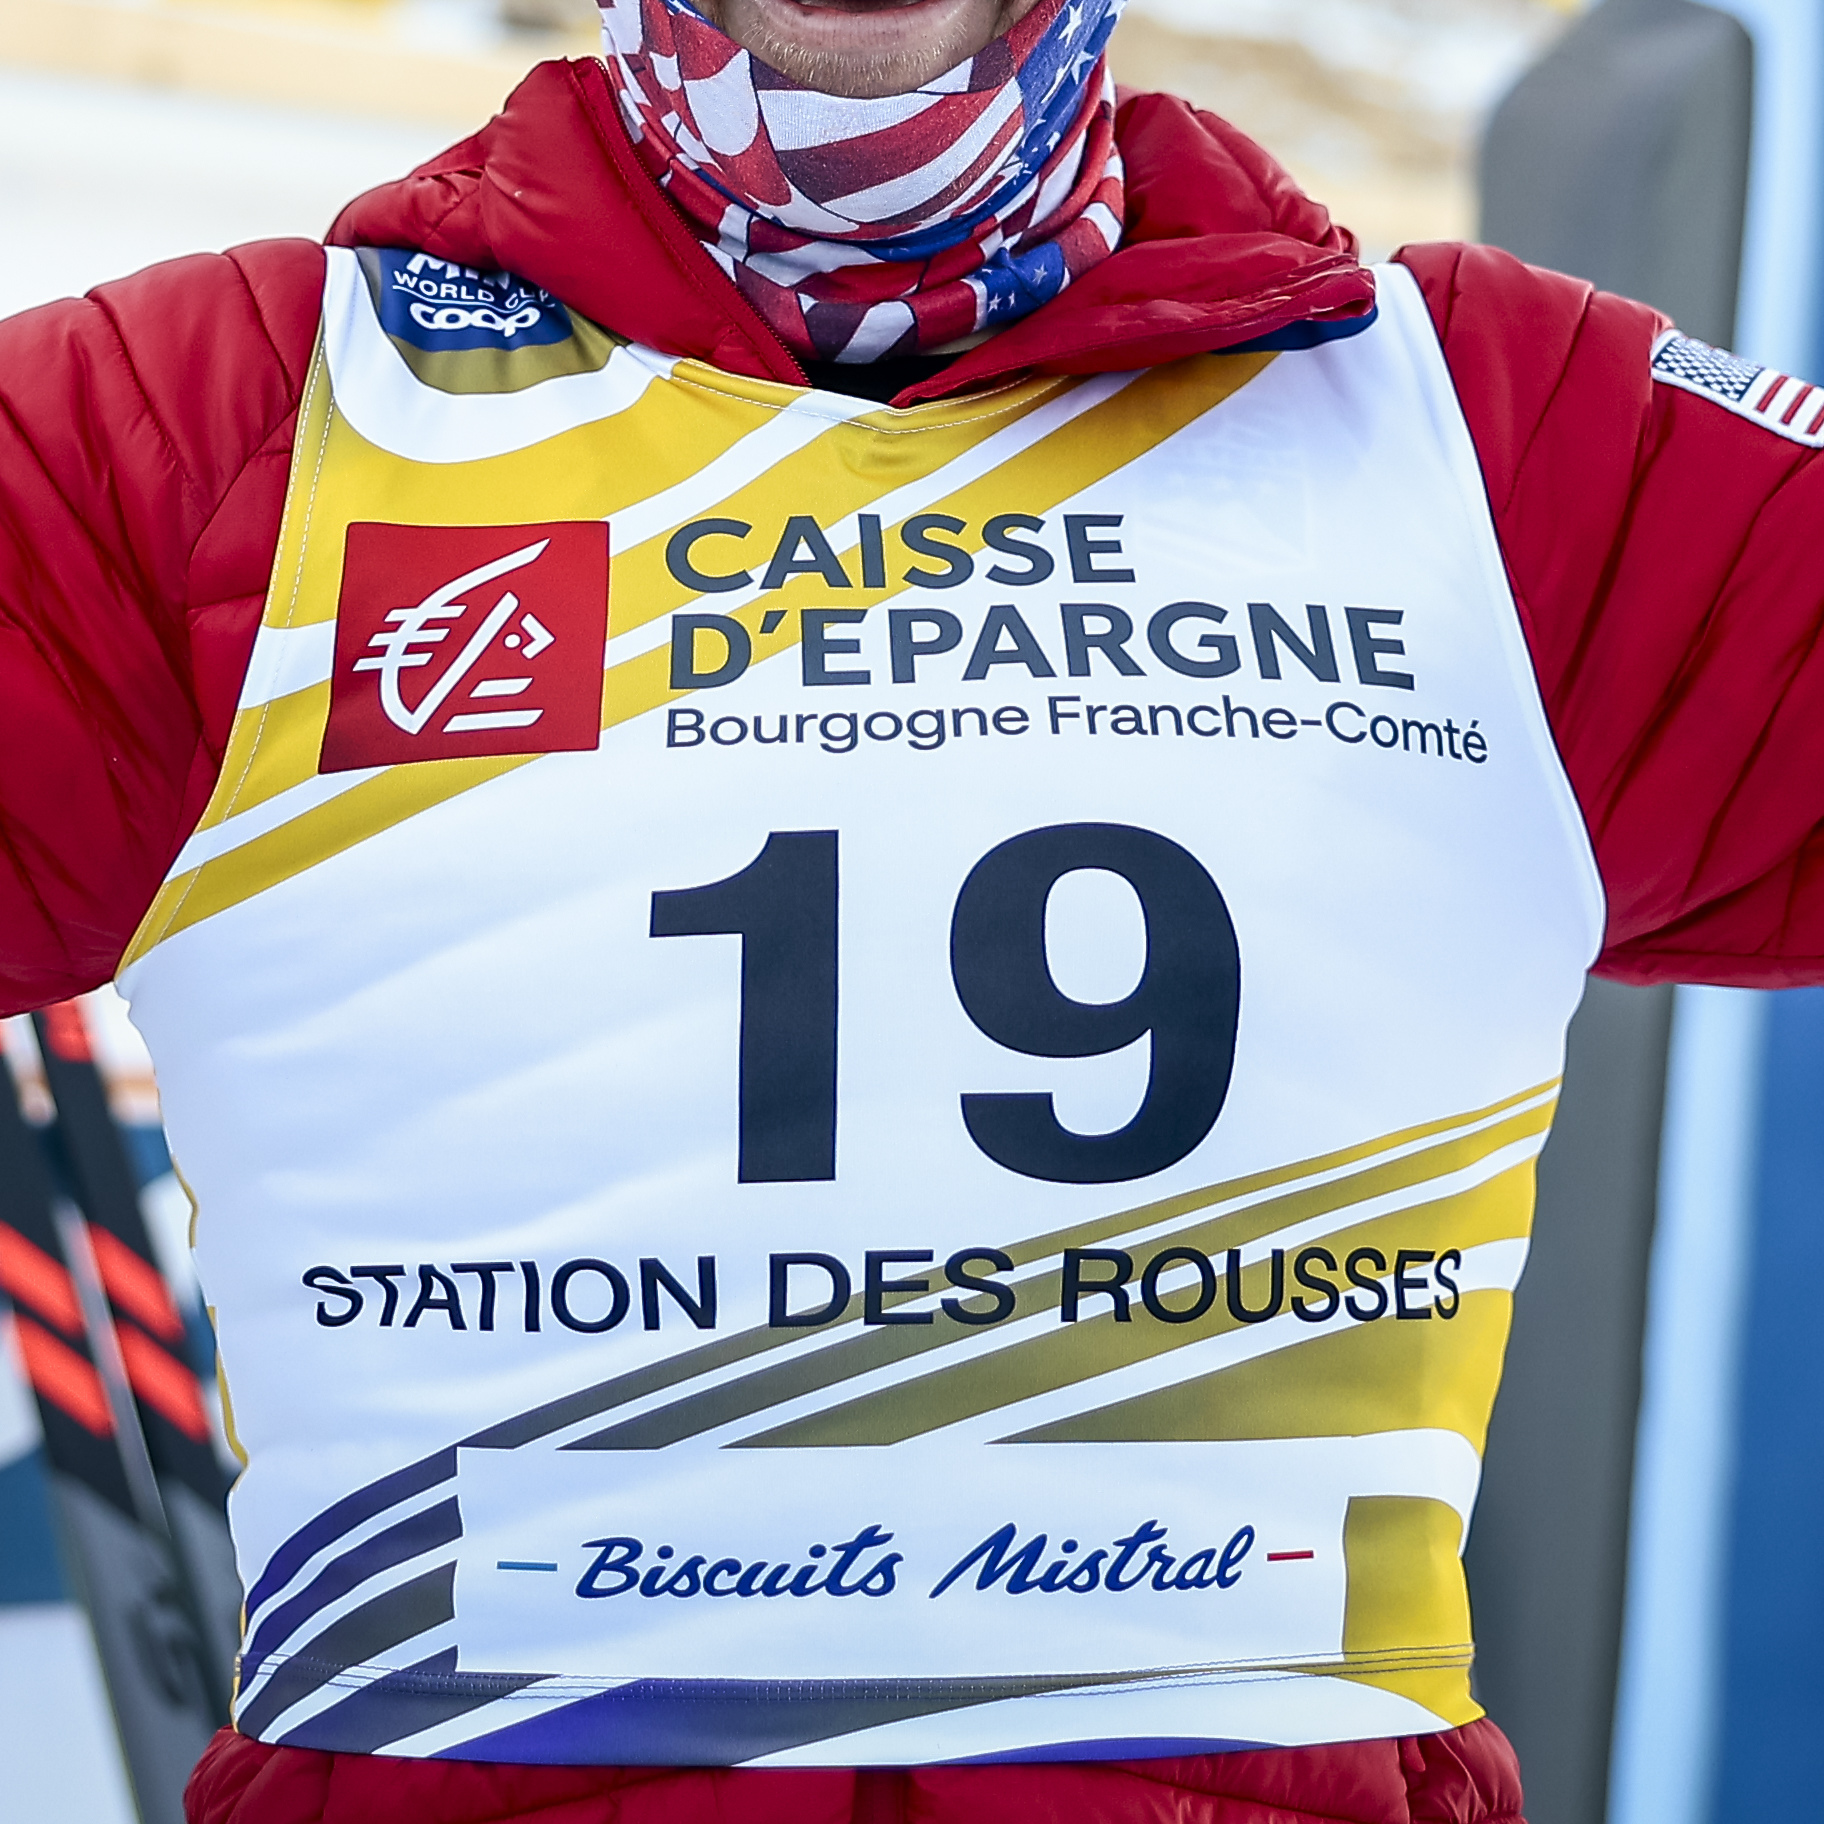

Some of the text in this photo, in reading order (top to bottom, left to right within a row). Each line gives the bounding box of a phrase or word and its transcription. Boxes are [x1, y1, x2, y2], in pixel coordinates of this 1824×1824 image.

[393, 270, 495, 303] WORLD
[409, 302, 542, 338] coop
[664, 512, 1137, 595] CAISSE
[666, 602, 1417, 693] D'EPARGNE
[665, 691, 1488, 765] Bourgogne Franche-Comté
[648, 821, 1242, 1185] 19
[301, 1245, 1463, 1332] STATION DES ROUSSES
[576, 1519, 1257, 1600] Biscuits Mistral
